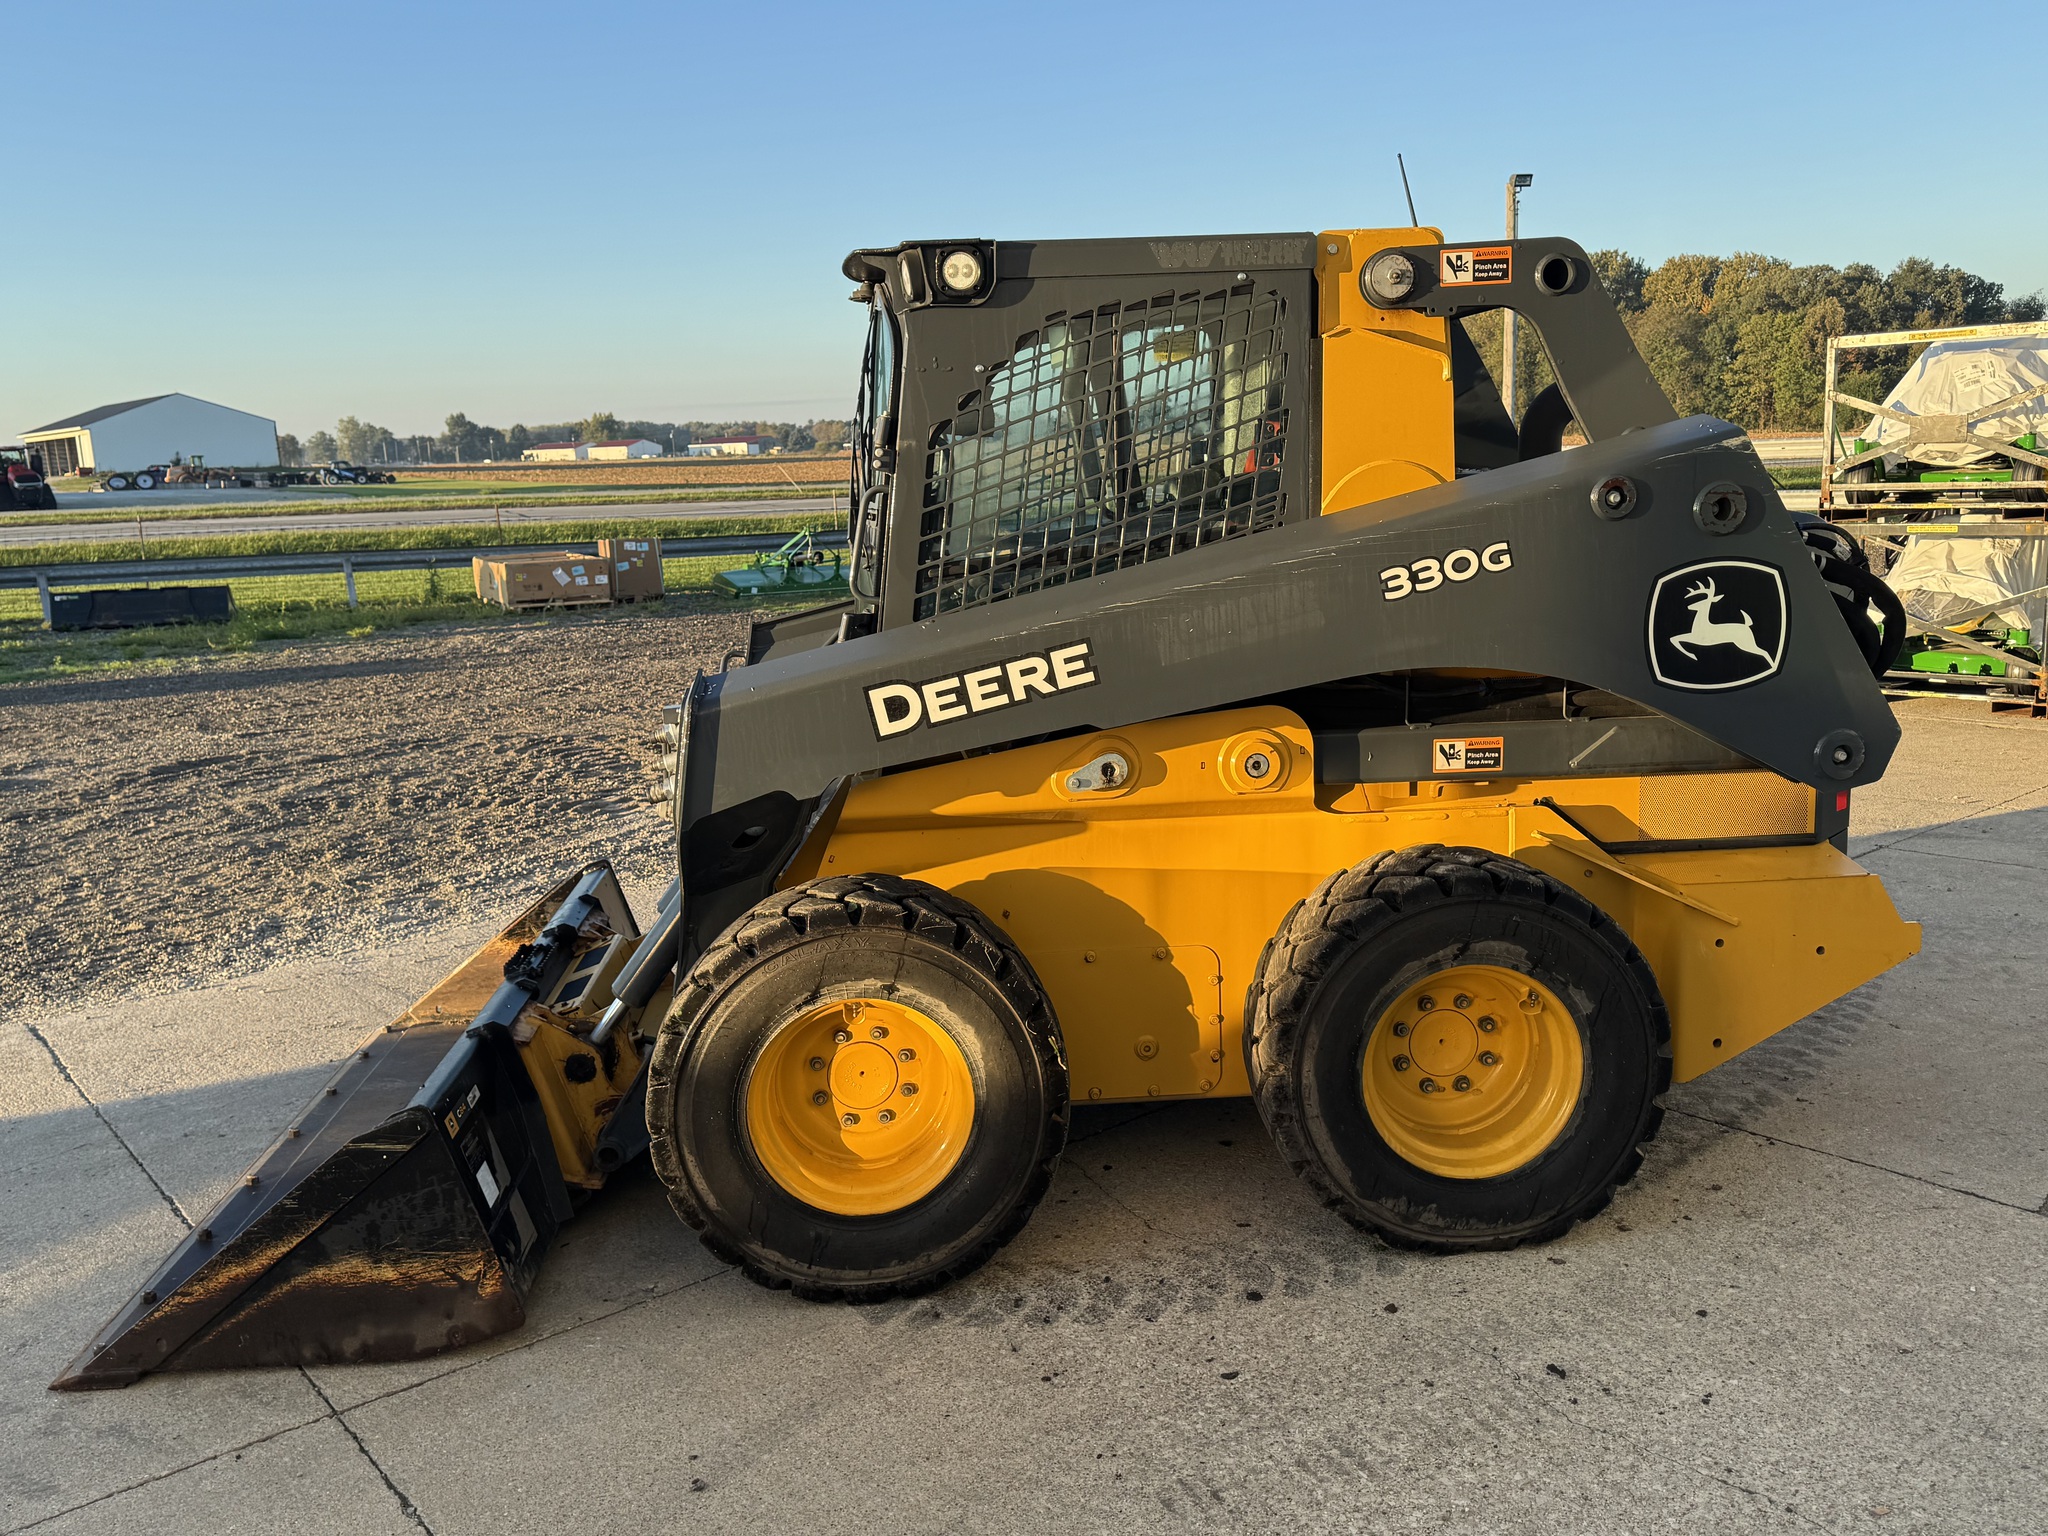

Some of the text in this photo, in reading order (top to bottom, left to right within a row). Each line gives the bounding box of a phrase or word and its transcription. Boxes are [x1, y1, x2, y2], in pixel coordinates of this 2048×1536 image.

[1380, 542, 1512, 600] 330G
[867, 643, 1096, 737] DEERE
[762, 936, 871, 975] GALAXY
